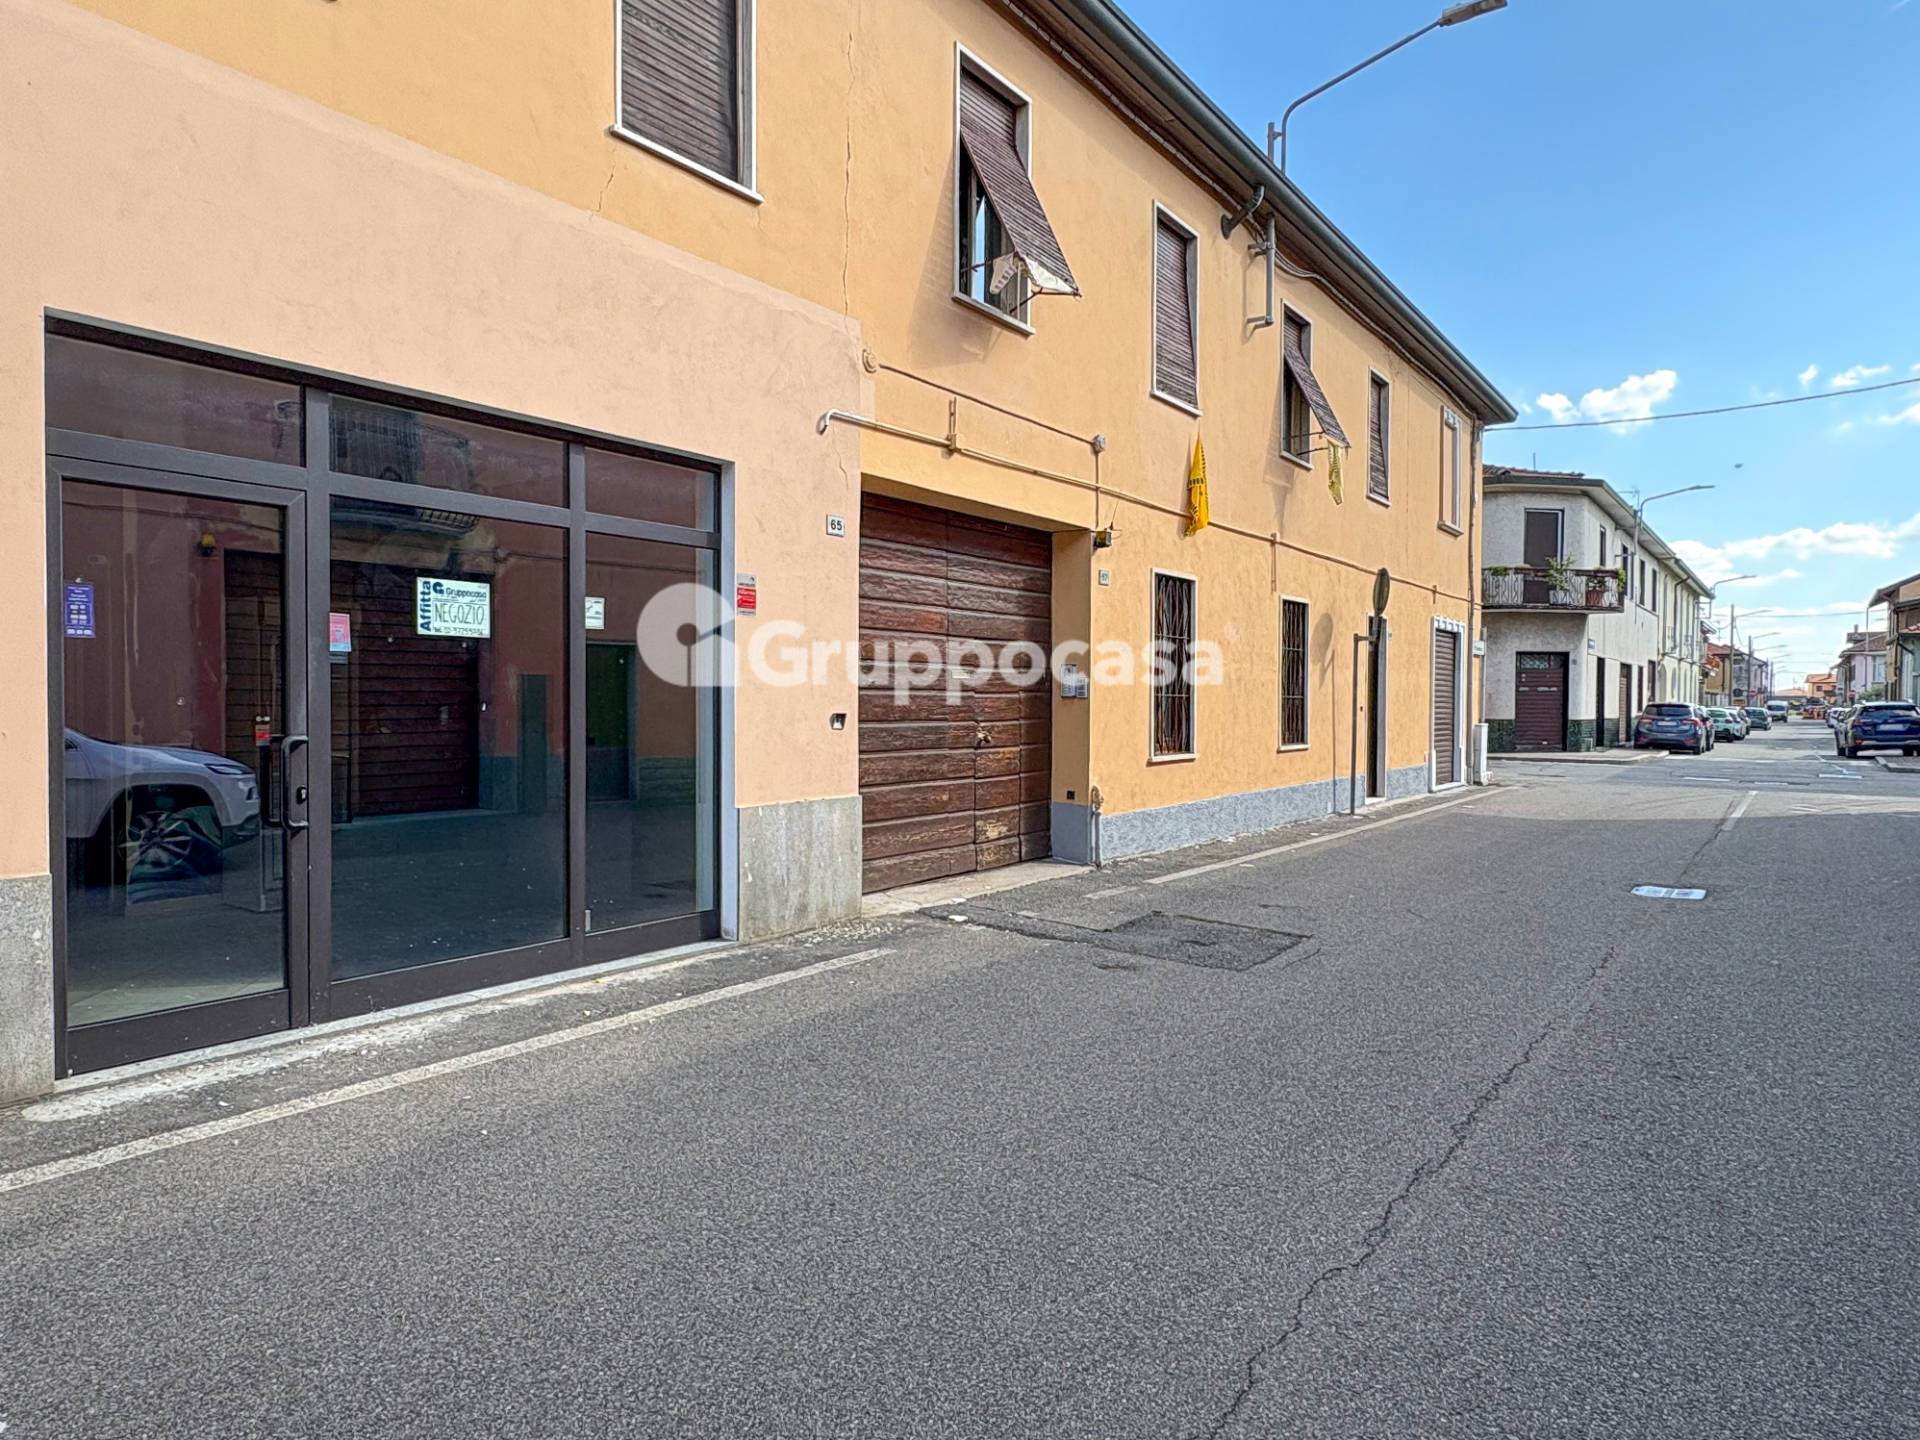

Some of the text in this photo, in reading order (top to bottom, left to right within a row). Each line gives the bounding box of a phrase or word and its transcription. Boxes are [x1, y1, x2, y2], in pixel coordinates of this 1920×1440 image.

[830, 519, 843, 531] 65
[445, 587, 487, 599] Gruppocasa
[420, 580, 431, 632] Affitta
[434, 603, 485, 625] NEGOZIO
